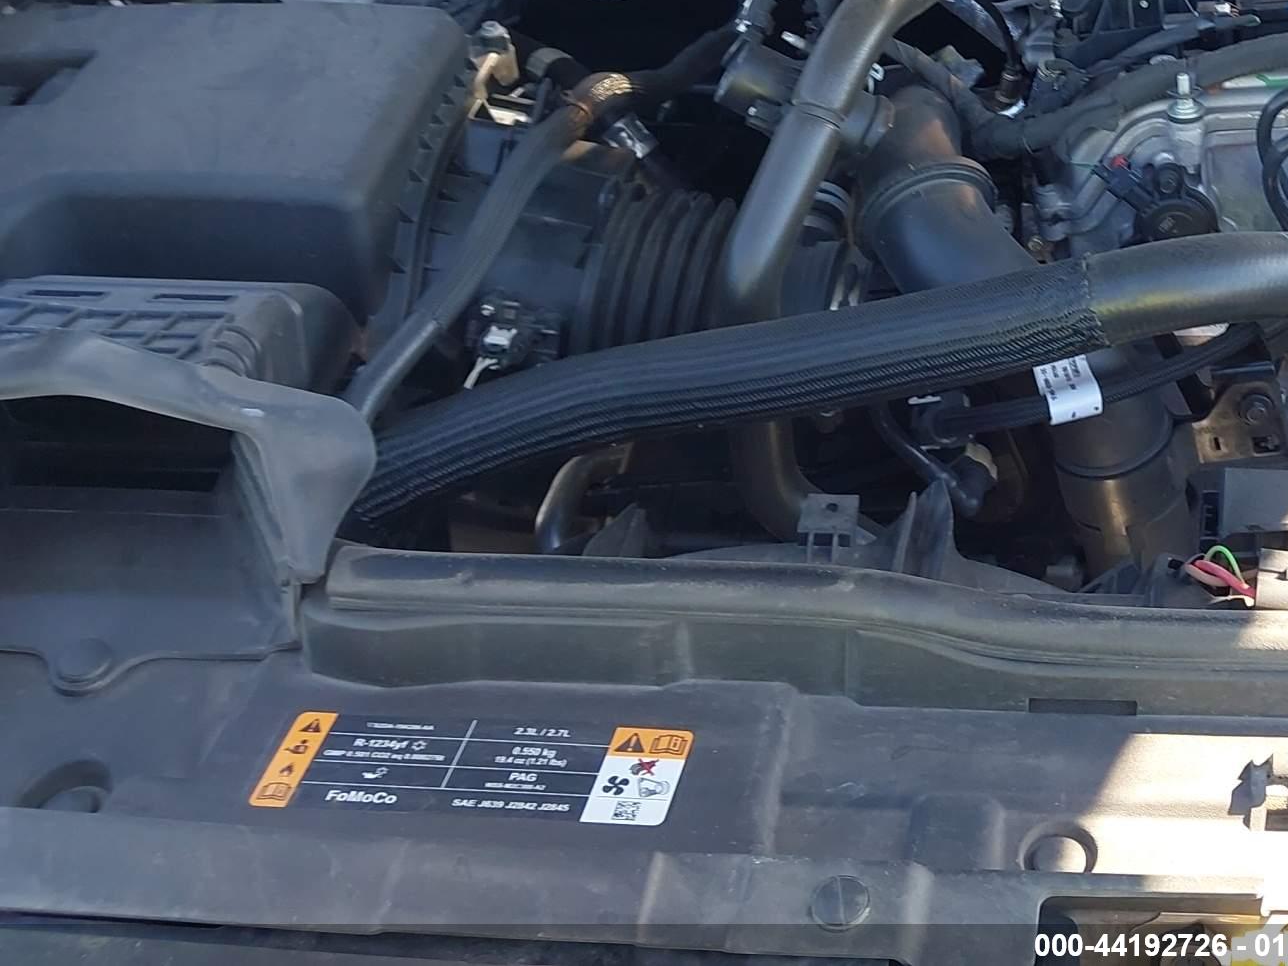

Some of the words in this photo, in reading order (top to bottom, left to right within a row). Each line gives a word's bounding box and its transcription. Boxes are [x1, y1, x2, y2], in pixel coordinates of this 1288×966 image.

[546, 729, 571, 738] 2.7L
[353, 738, 410, 750] R-1234yf
[542, 747, 558, 759] kg
[508, 772, 538, 782] PAG
[325, 789, 398, 804] FoMoCo
[451, 798, 477, 808] SAE
[477, 799, 505, 809] J639
